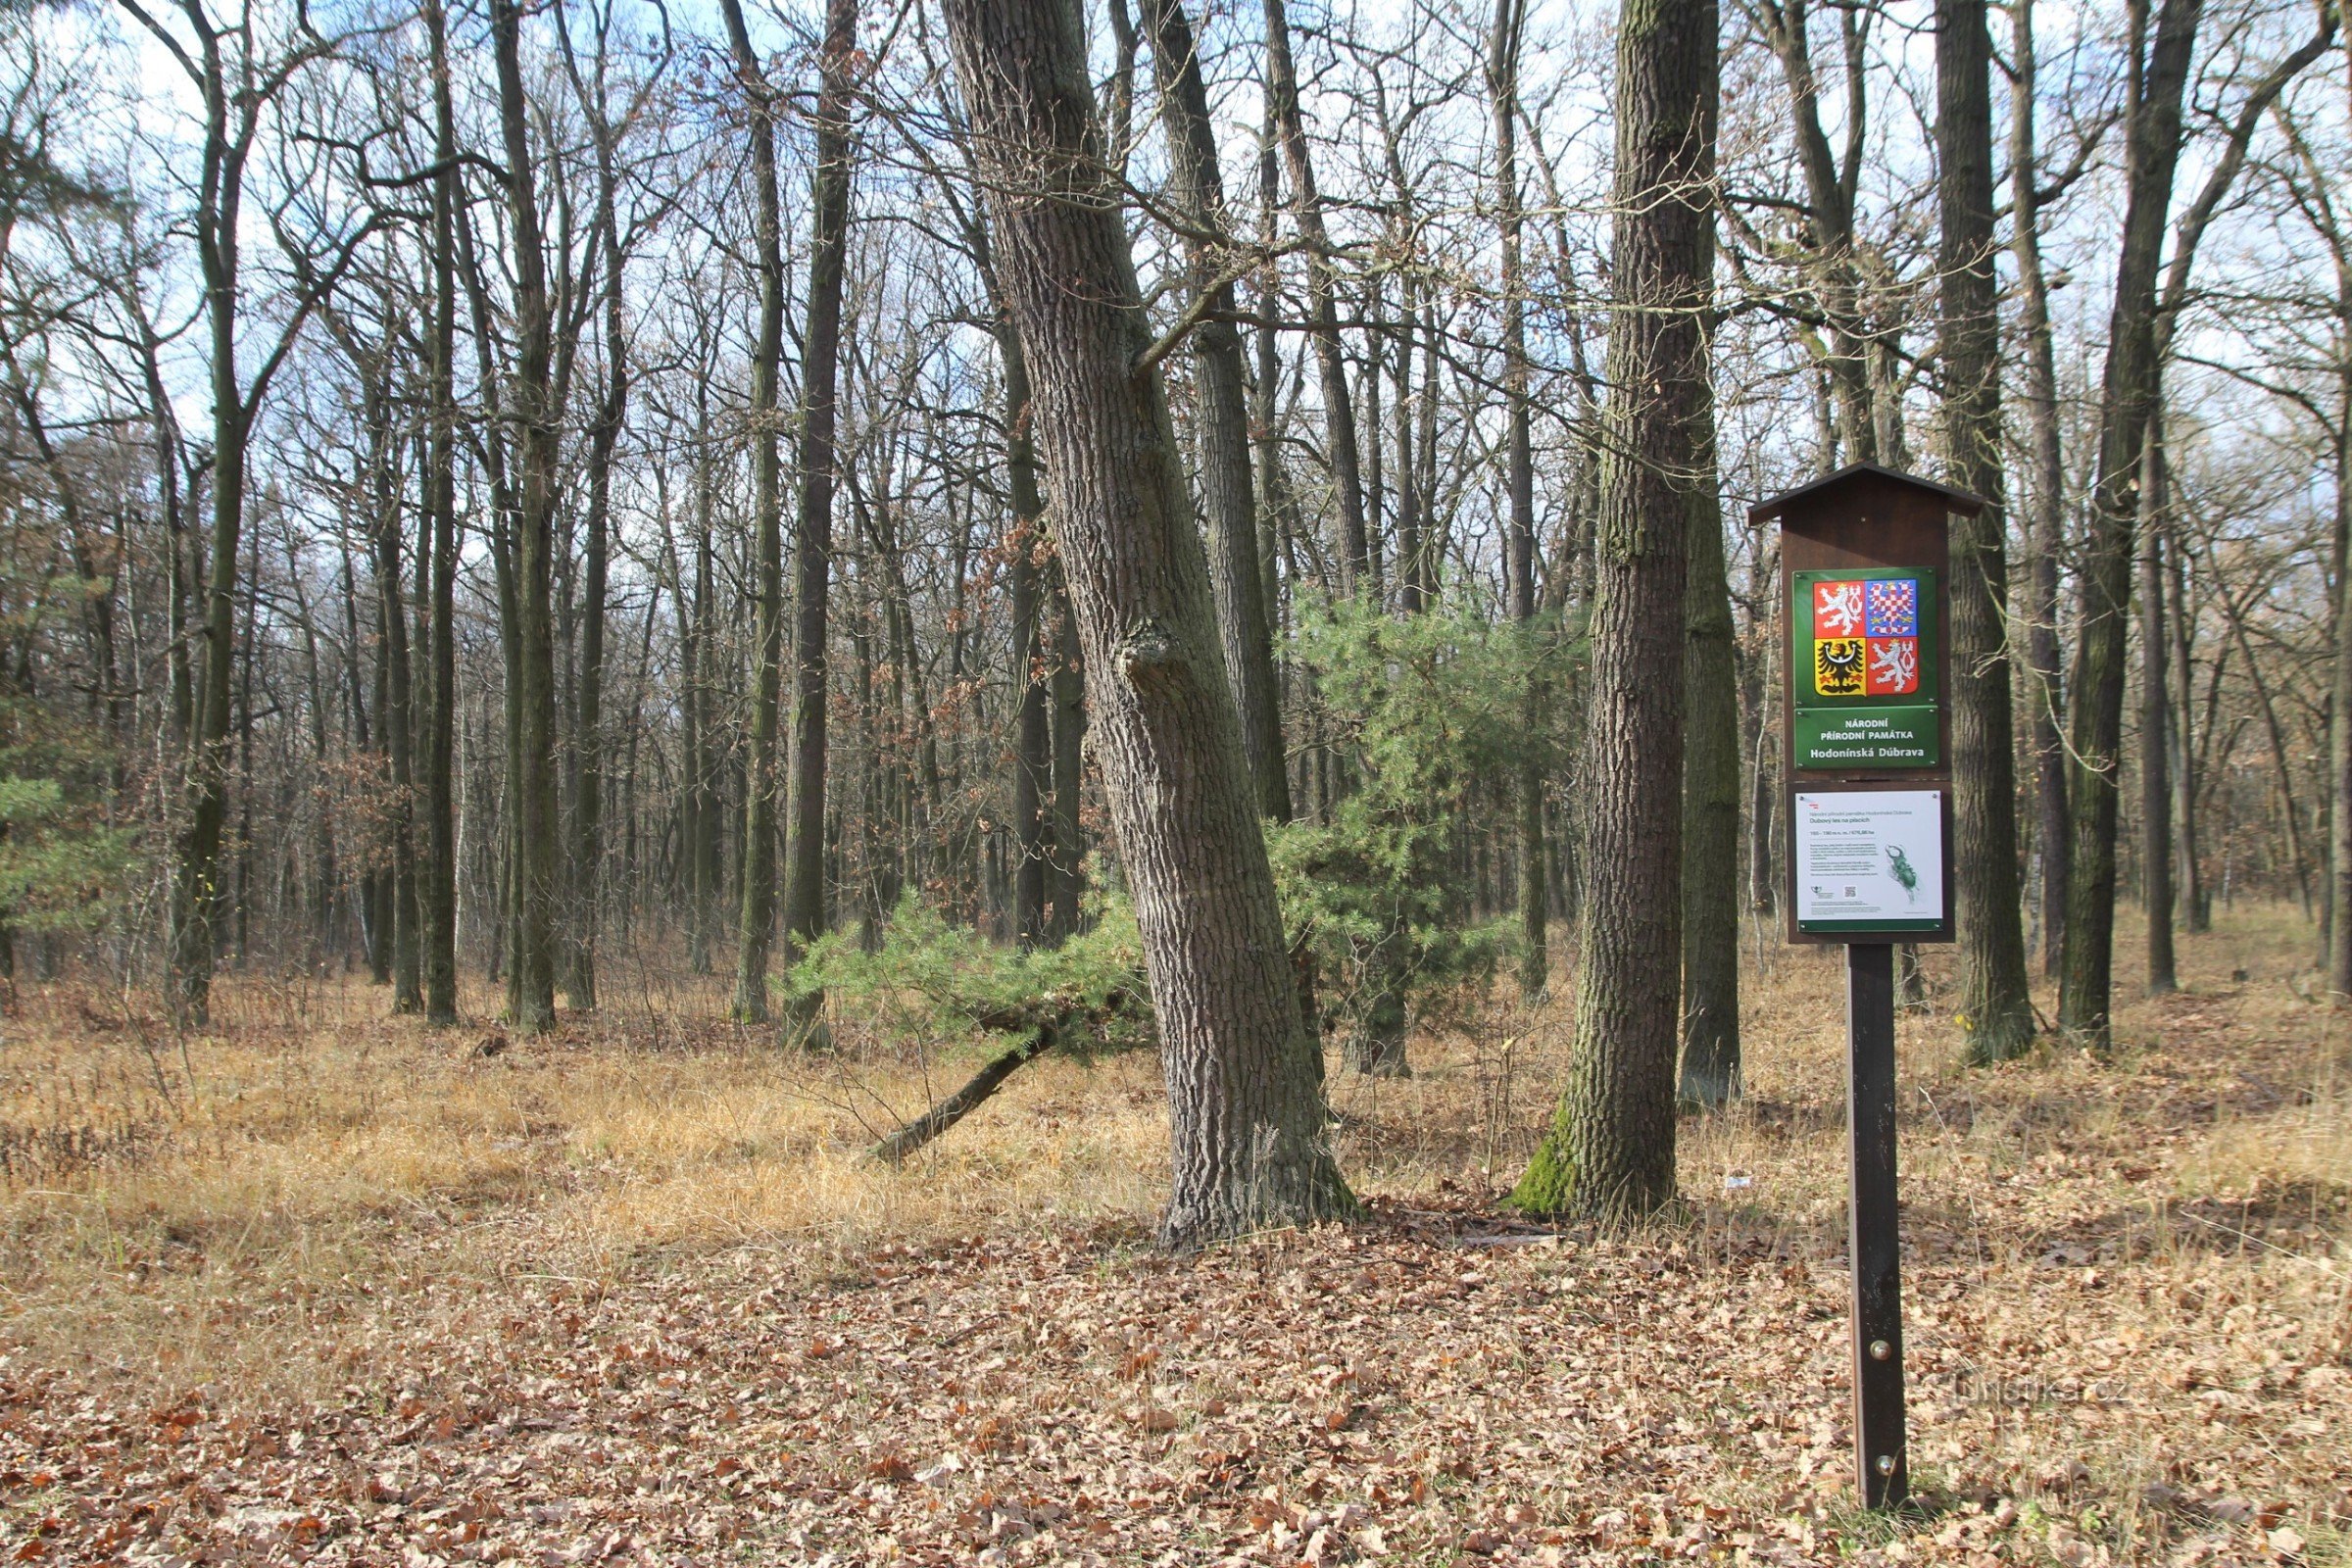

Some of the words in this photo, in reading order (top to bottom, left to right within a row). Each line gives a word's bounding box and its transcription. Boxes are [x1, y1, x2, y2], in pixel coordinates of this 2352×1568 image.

[1844, 717, 1888, 728] NÁRODNÍ
[1820, 730, 1865, 741] PŘÍRODNÍ
[1868, 729, 1914, 740] PAMÁTKA
[1811, 748, 1874, 759] Hodonínská
[1879, 747, 1925, 758] Dúbrava
